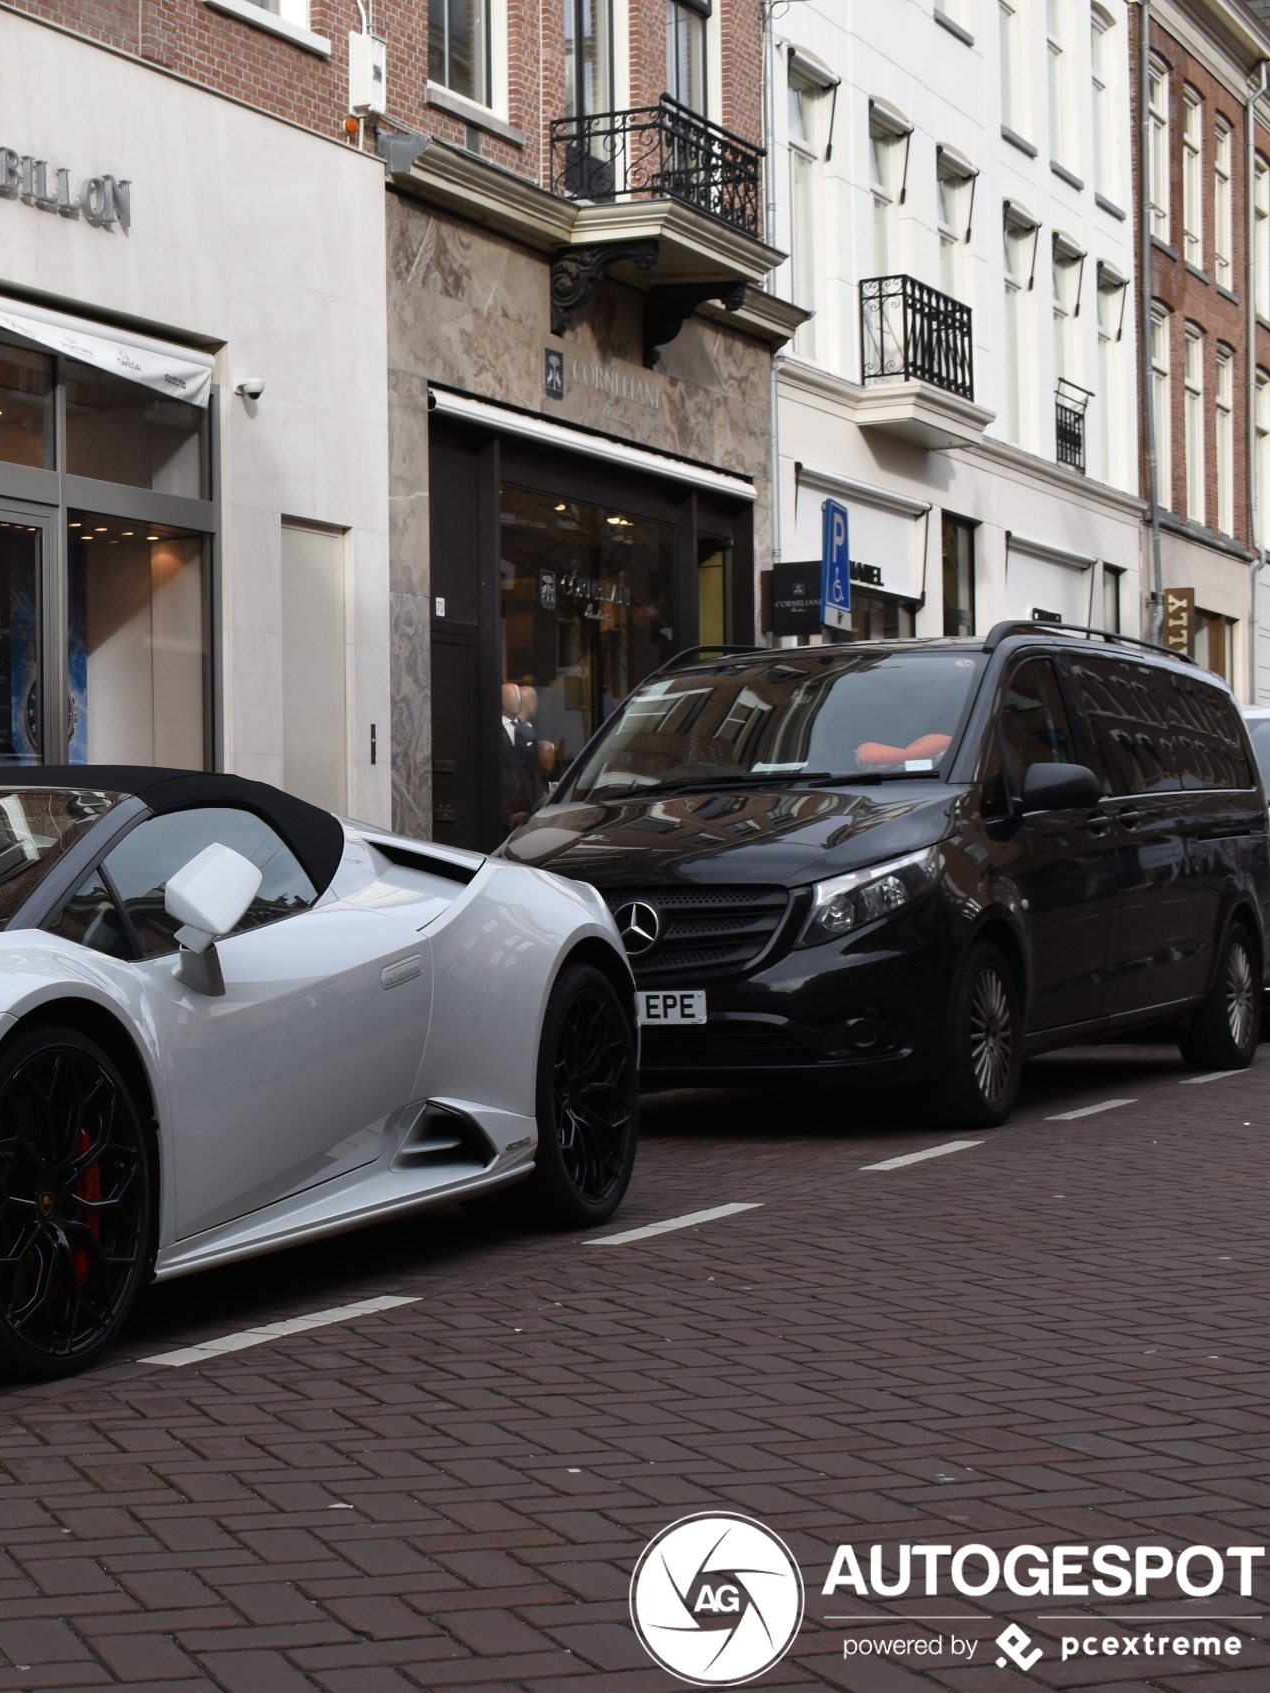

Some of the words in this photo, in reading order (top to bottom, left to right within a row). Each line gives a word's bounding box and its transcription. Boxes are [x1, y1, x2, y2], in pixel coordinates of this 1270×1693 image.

[571, 358, 660, 410] CORNELIANI
[833, 512, 845, 563] P
[645, 994, 696, 1019] EPE
